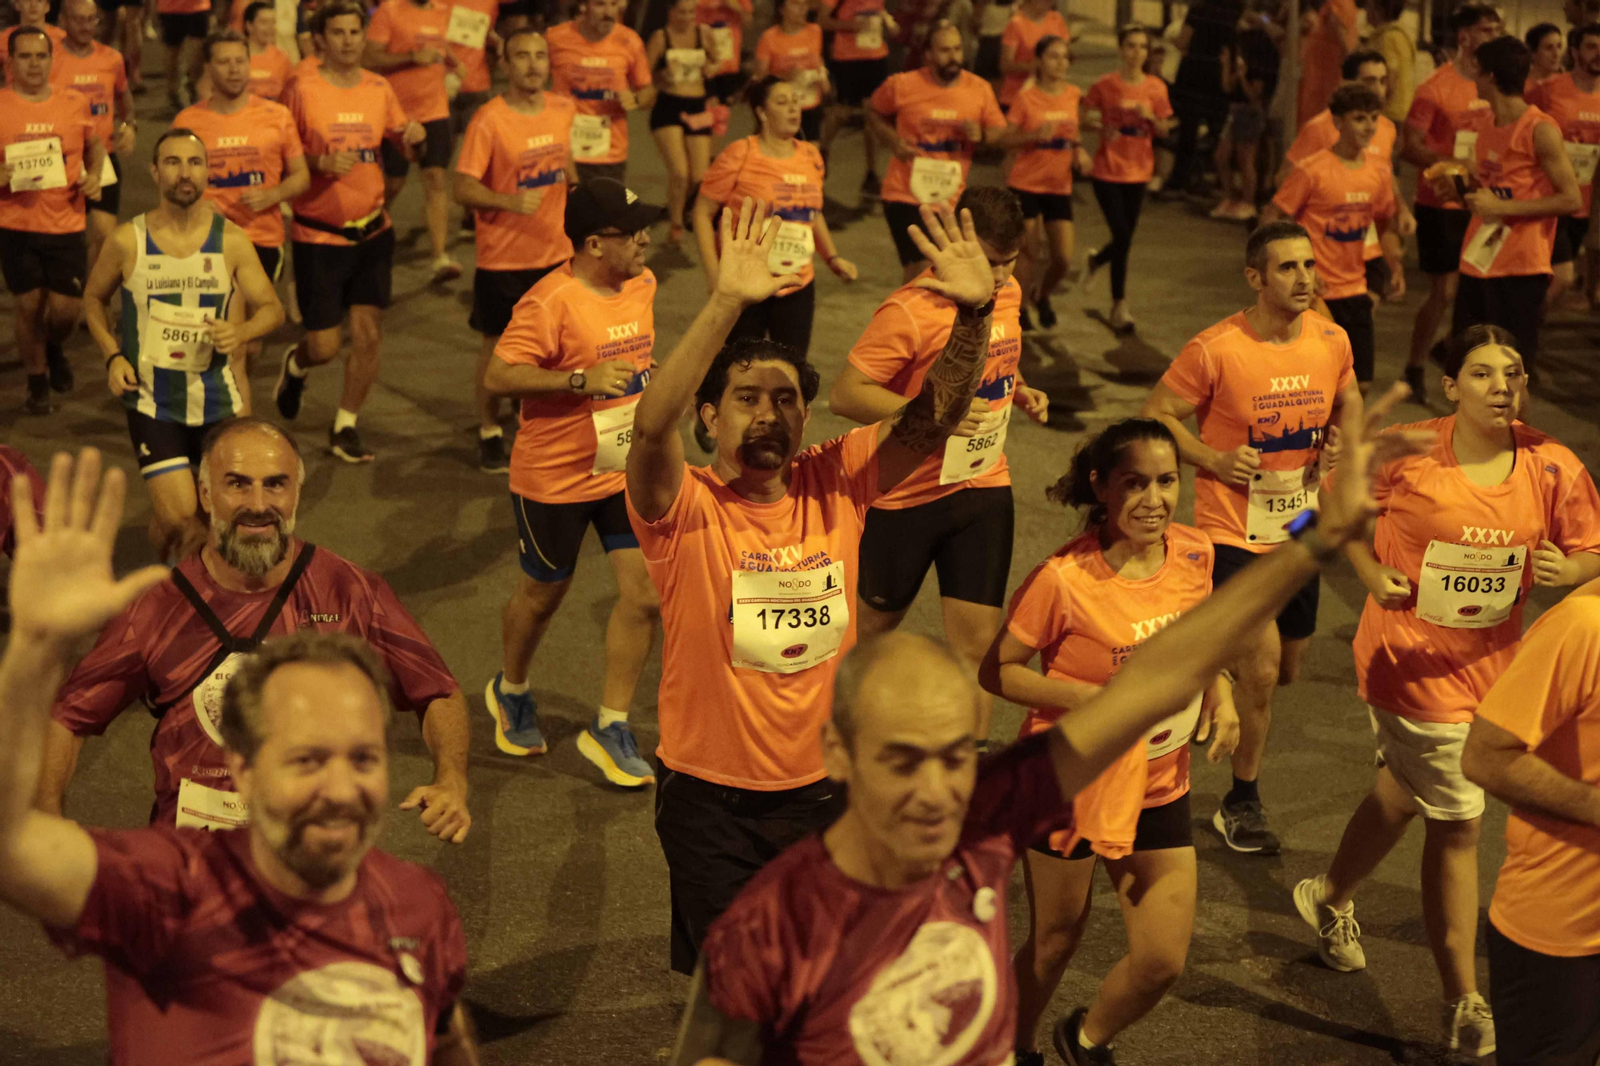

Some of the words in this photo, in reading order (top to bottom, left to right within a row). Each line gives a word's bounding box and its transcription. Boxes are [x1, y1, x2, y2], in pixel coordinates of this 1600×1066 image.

[18, 156, 54, 170] 13705
[146, 278, 153, 290] La
[155, 276, 181, 289] Luisiana
[188, 276, 194, 288] El
[607, 321, 638, 341] XXXV
[602, 340, 652, 358] GUADALQUIVIR
[1270, 374, 1310, 392] XXXV
[1253, 393, 1286, 402] CARRERA
[1289, 389, 1324, 399] NOCTURNA
[1258, 396, 1325, 410] GUADALQUIVIR
[616, 429, 633, 447] 58
[966, 432, 998, 453] 5862
[1265, 489, 1308, 513] 13451
[1460, 525, 1515, 546] XXXV
[1441, 574, 1507, 594] 16033
[756, 604, 832, 631] 17338
[783, 646, 804, 656] KH7
